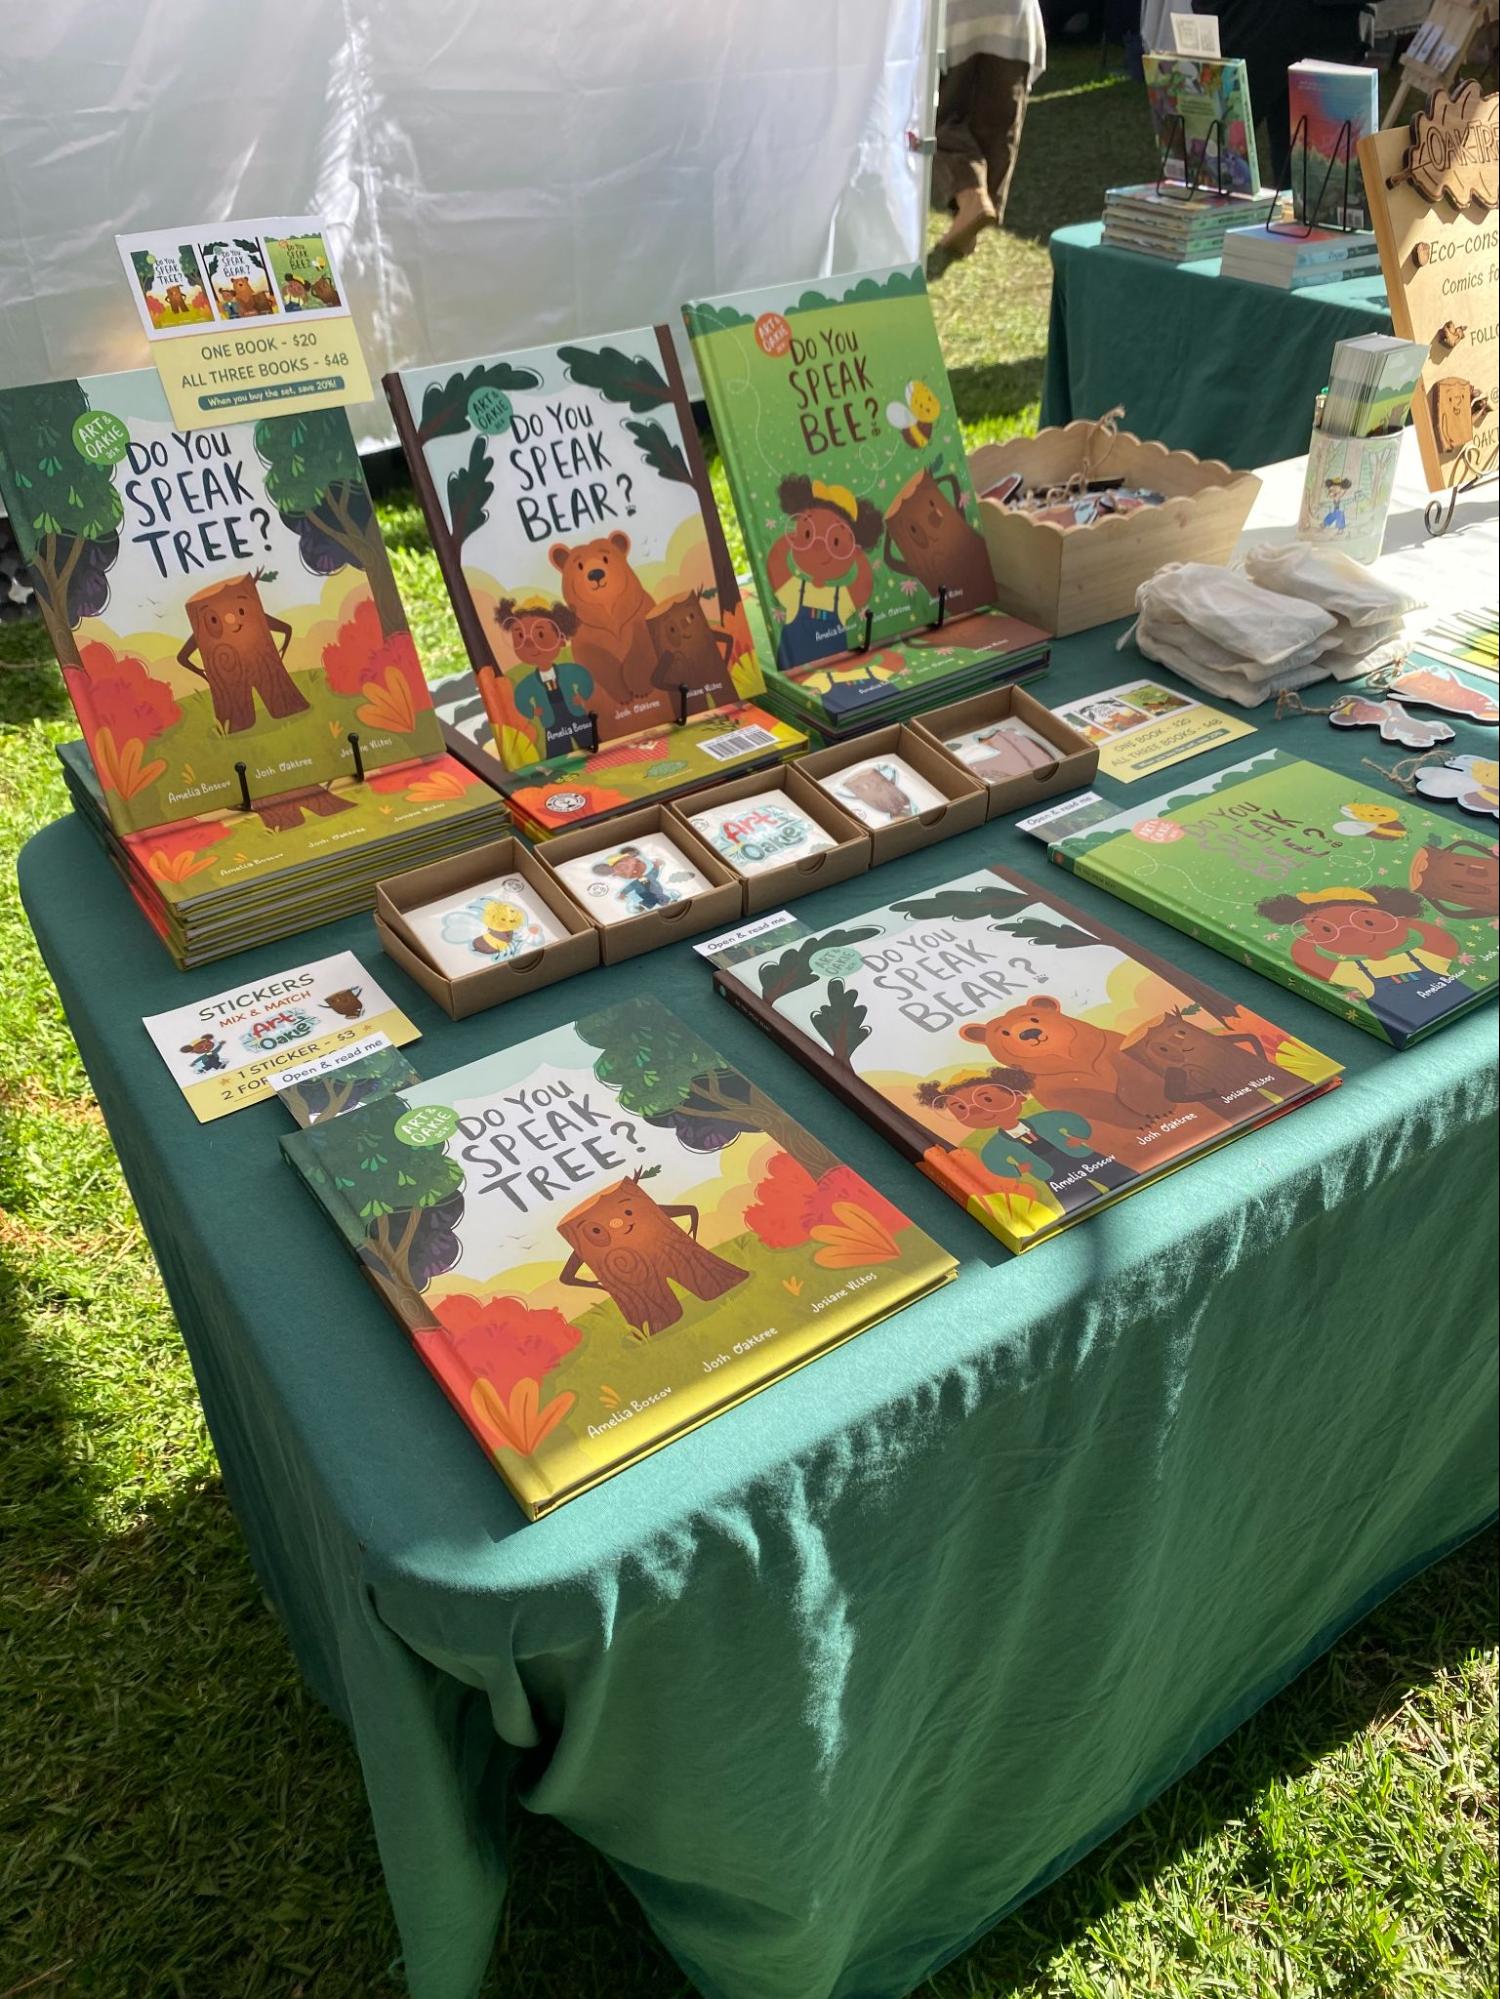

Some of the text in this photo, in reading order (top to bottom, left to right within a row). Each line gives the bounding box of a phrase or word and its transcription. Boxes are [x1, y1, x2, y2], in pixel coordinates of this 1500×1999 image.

[1442, 272, 1484, 296] Comics
[201, 344, 232, 360] ONE
[235, 338, 278, 356] BOOK
[293, 332, 316, 347] $20
[789, 338, 817, 366] DO
[820, 328, 859, 357] YOU
[182, 374, 206, 388] ALL
[209, 366, 255, 384] THREE
[258, 358, 309, 377] BOOKS
[324, 352, 349, 367] $48
[788, 356, 874, 409] SPEAK
[208, 396, 232, 407] When
[233, 395, 247, 405] you
[248, 391, 263, 402] buy
[265, 388, 279, 397] the
[298, 385, 314, 393] save
[316, 379, 336, 391] 20%!
[79, 417, 103, 443] ART
[510, 402, 593, 444] DO YOU
[800, 397, 881, 456] BEE?
[86, 425, 124, 458] OAKIE
[124, 430, 232, 476] DO YOU
[510, 431, 612, 491] SPEAK
[124, 461, 254, 527] SPEAK
[516, 473, 637, 542] BEAR?
[132, 507, 272, 578] TREE?
[547, 726, 573, 741] Amelia
[255, 758, 313, 779] Josh Oaktree
[168, 780, 231, 804] Amelia Boscov
[722, 811, 778, 844] Art
[1027, 814, 1050, 825] Open
[1182, 819, 1217, 838] DO
[1208, 802, 1261, 822] YOU
[741, 826, 804, 860] Oakie
[707, 917, 786, 950] Open & read me
[860, 950, 903, 973] DO
[897, 929, 958, 953] YOU
[815, 952, 834, 969] ART
[825, 951, 855, 975] OAKIE
[873, 939, 997, 1000] SPEAK
[199, 973, 315, 1022] STICKERS
[899, 958, 1049, 1033] BEAR?
[1416, 981, 1447, 998] Amelia
[219, 990, 311, 1028] MIX & MATCH
[253, 1012, 296, 1038] Art
[250, 1043, 321, 1075] STICKER
[337, 1030, 356, 1041] $3
[260, 1022, 311, 1050] Oakie
[282, 1066, 317, 1083] Open
[320, 1061, 332, 1070] &
[335, 1048, 362, 1064] read
[364, 1039, 383, 1050] me
[221, 1090, 233, 1100] 2
[455, 1080, 574, 1141] DO YOU
[1221, 1087, 1252, 1103] Josiane
[401, 1112, 428, 1134] ART
[411, 1112, 451, 1143] OAKIE
[462, 1094, 611, 1178] SPEAK
[1136, 1114, 1198, 1145] Josh Oaktree
[478, 1122, 646, 1213] TREE?
[1050, 1155, 1116, 1192] Amelia Boscov
[812, 1290, 848, 1312] Josiane
[702, 1328, 778, 1373] Josh Oaktree
[588, 1386, 671, 1439] Amelia Boscov
